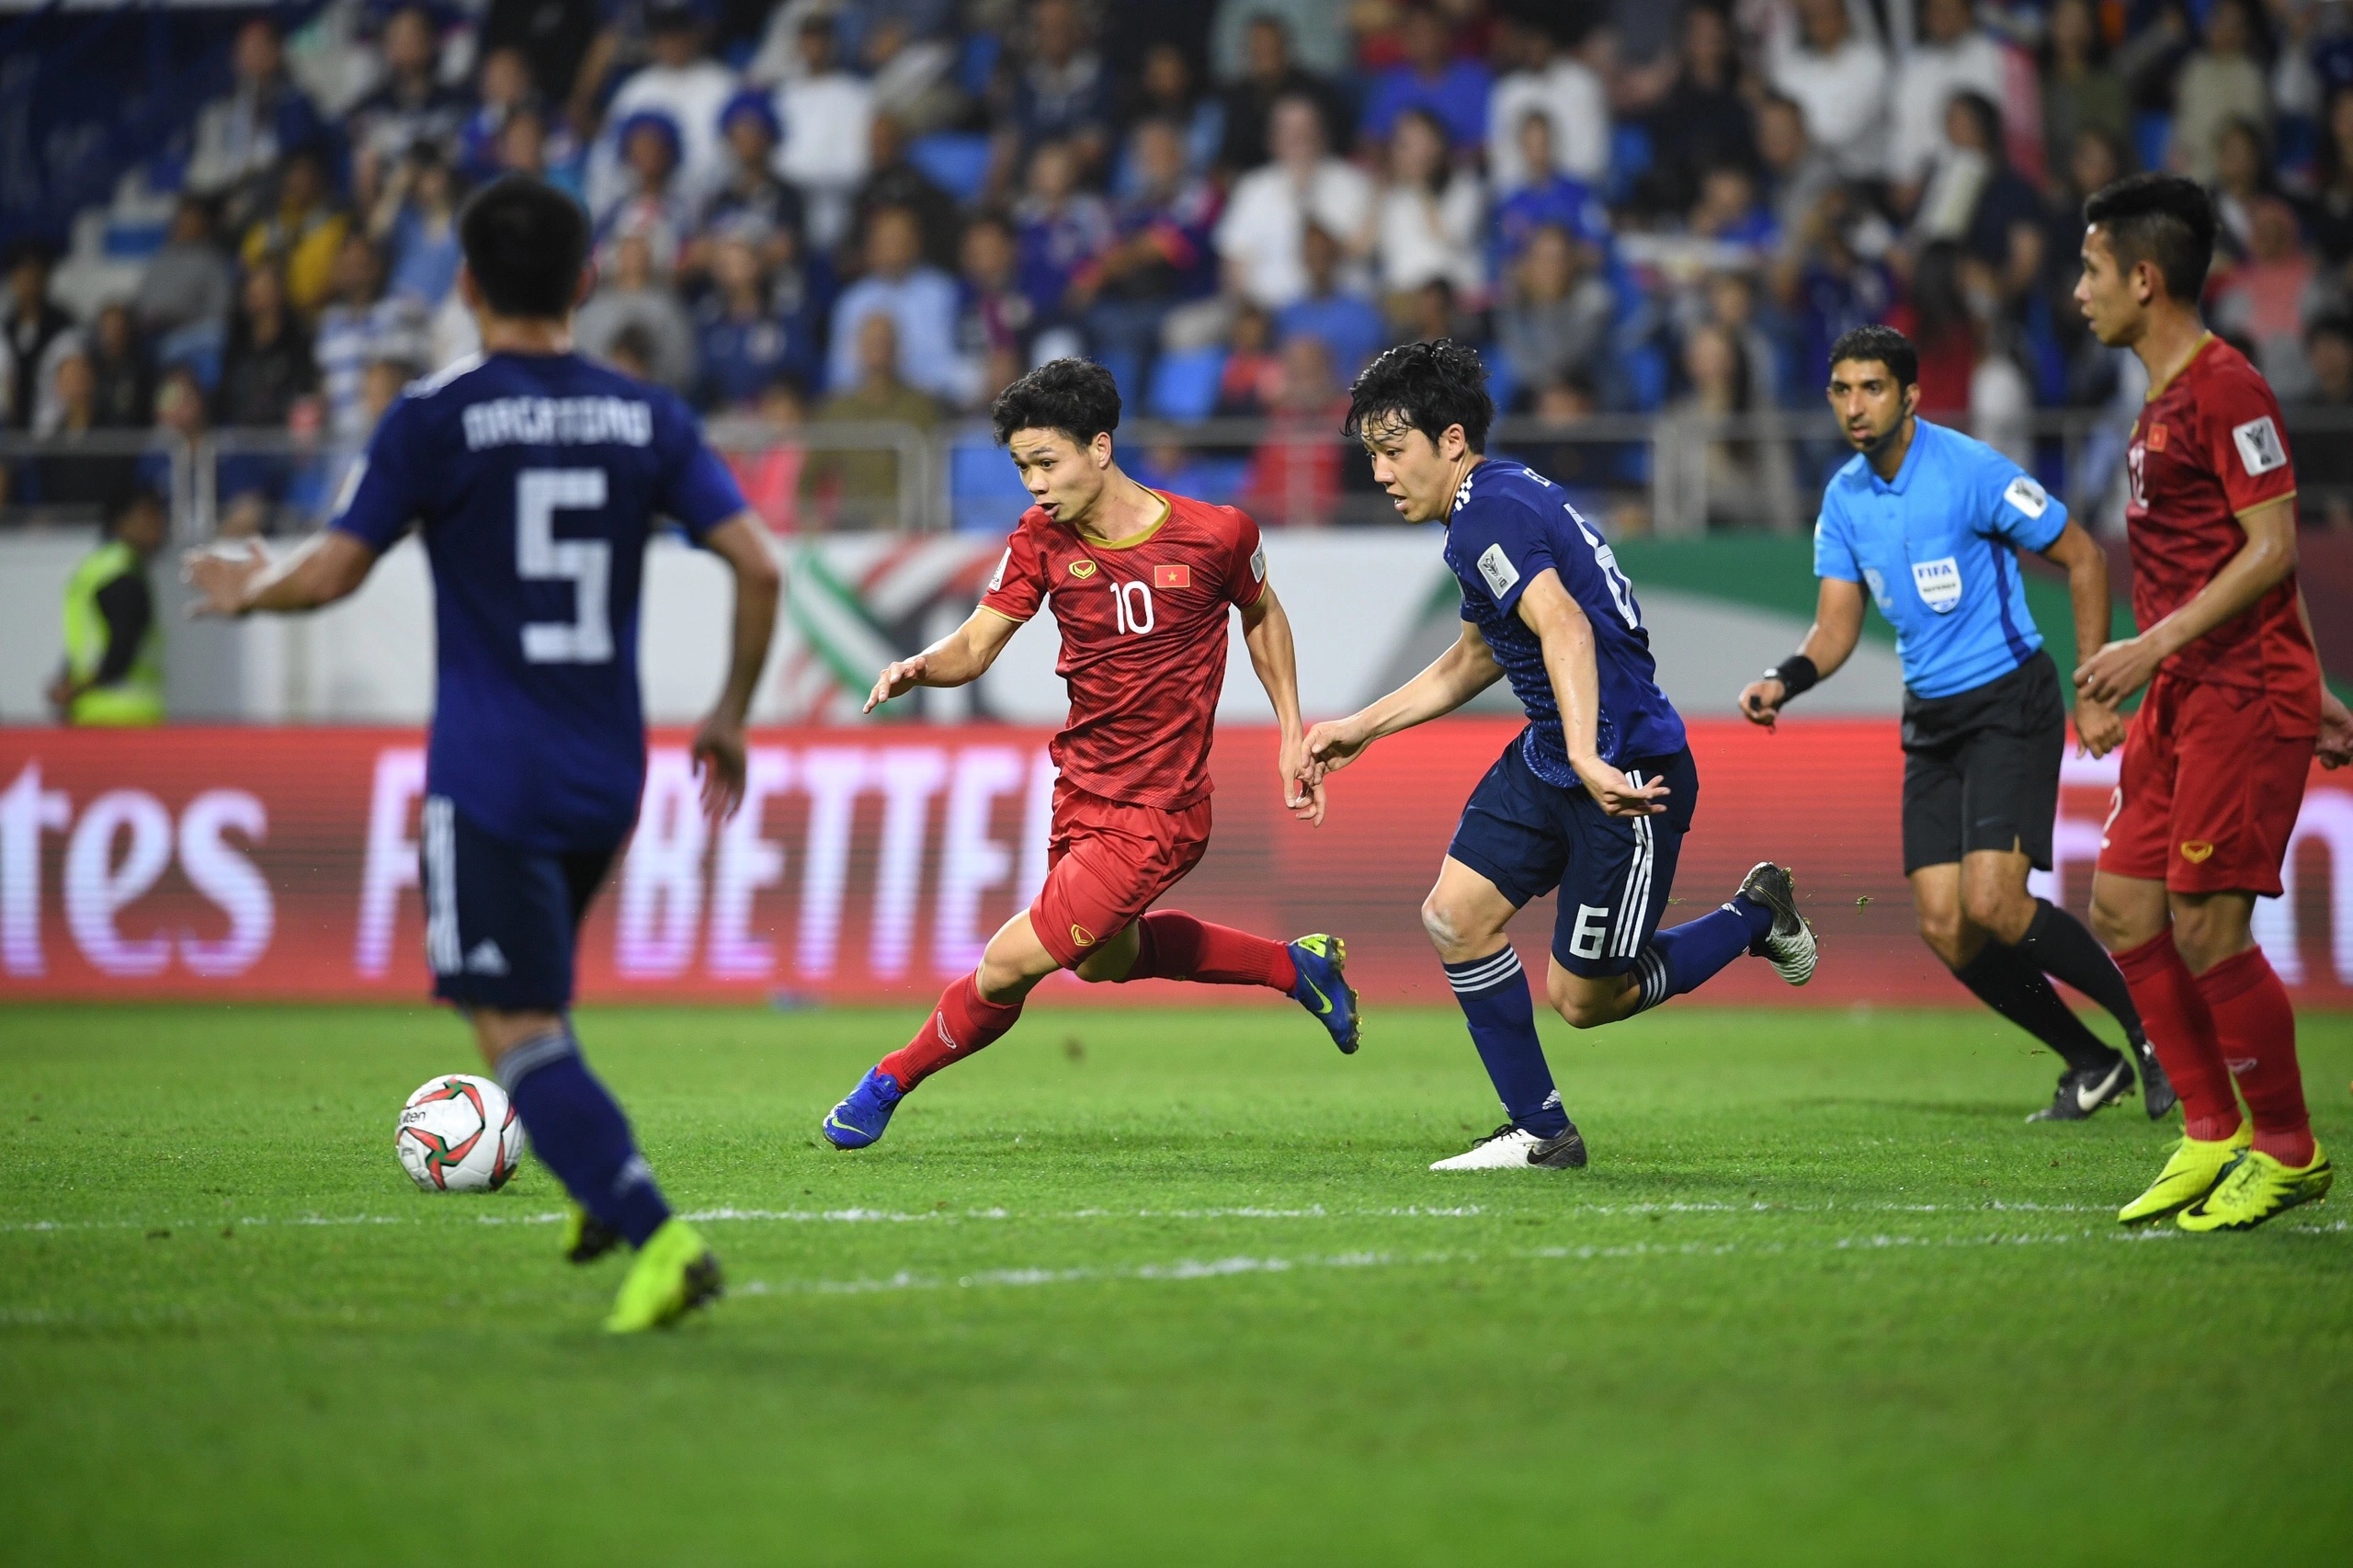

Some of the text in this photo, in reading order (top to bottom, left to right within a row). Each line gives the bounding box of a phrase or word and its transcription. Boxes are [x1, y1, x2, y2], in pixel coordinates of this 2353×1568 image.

[516, 467, 614, 664] 5
[1917, 564, 1952, 578] FIFA
[1109, 580, 1154, 634] 10
[1569, 903, 1608, 960] 6
